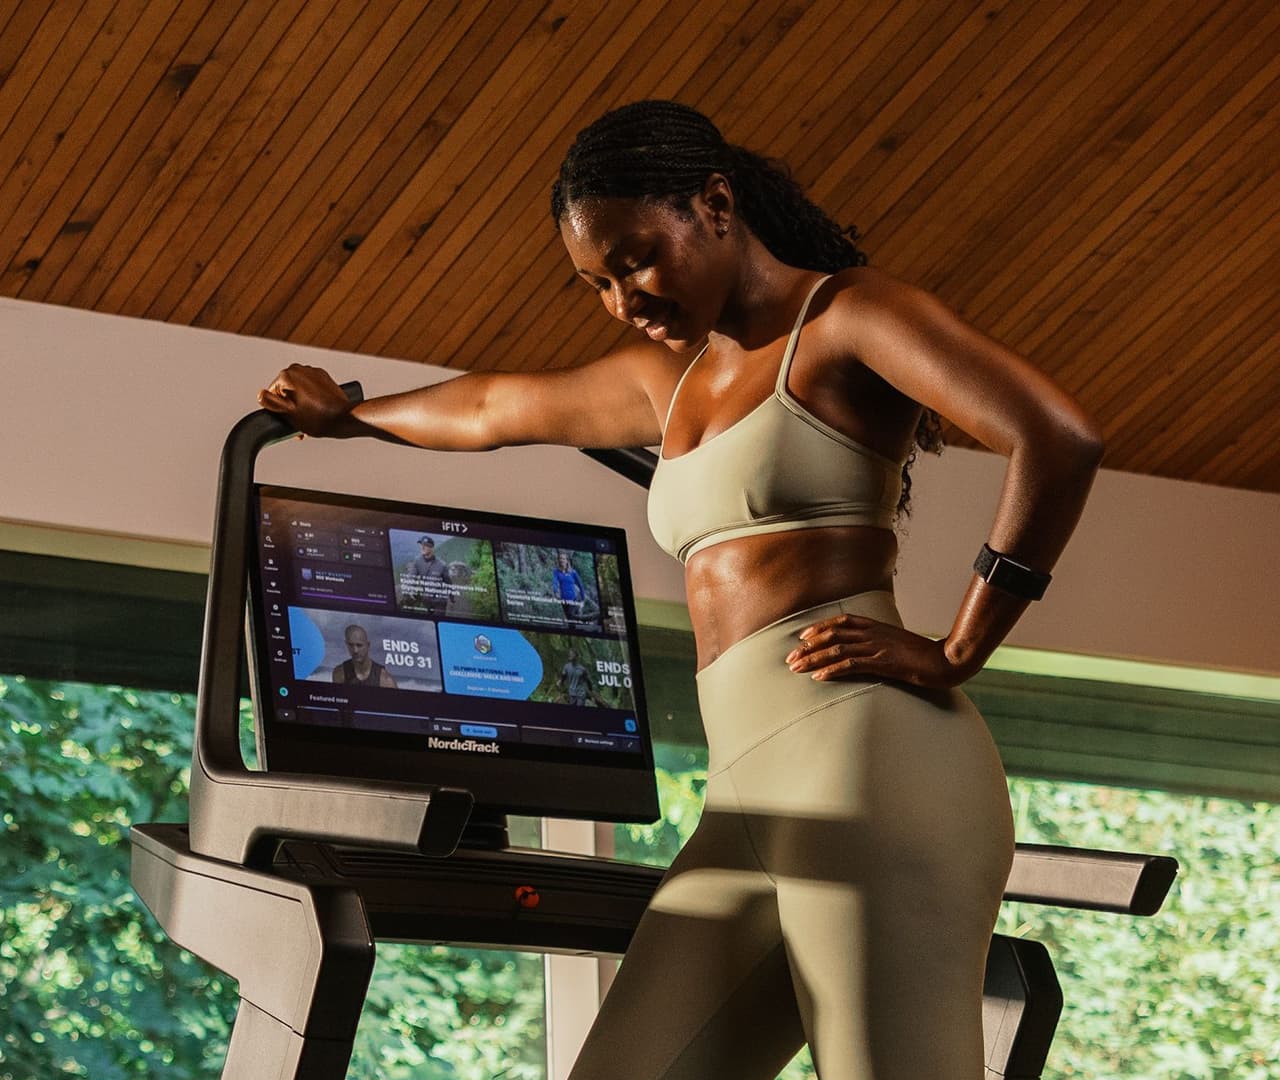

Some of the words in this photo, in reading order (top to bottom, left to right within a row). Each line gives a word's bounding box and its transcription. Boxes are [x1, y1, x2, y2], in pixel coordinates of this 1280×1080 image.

[382, 638, 419, 654] ENDS
[384, 653, 414, 667] AUG
[417, 656, 432, 669] 31
[596, 660, 630, 675] ENDS
[598, 674, 621, 688] JUL
[427, 736, 500, 754] NordicTrack
